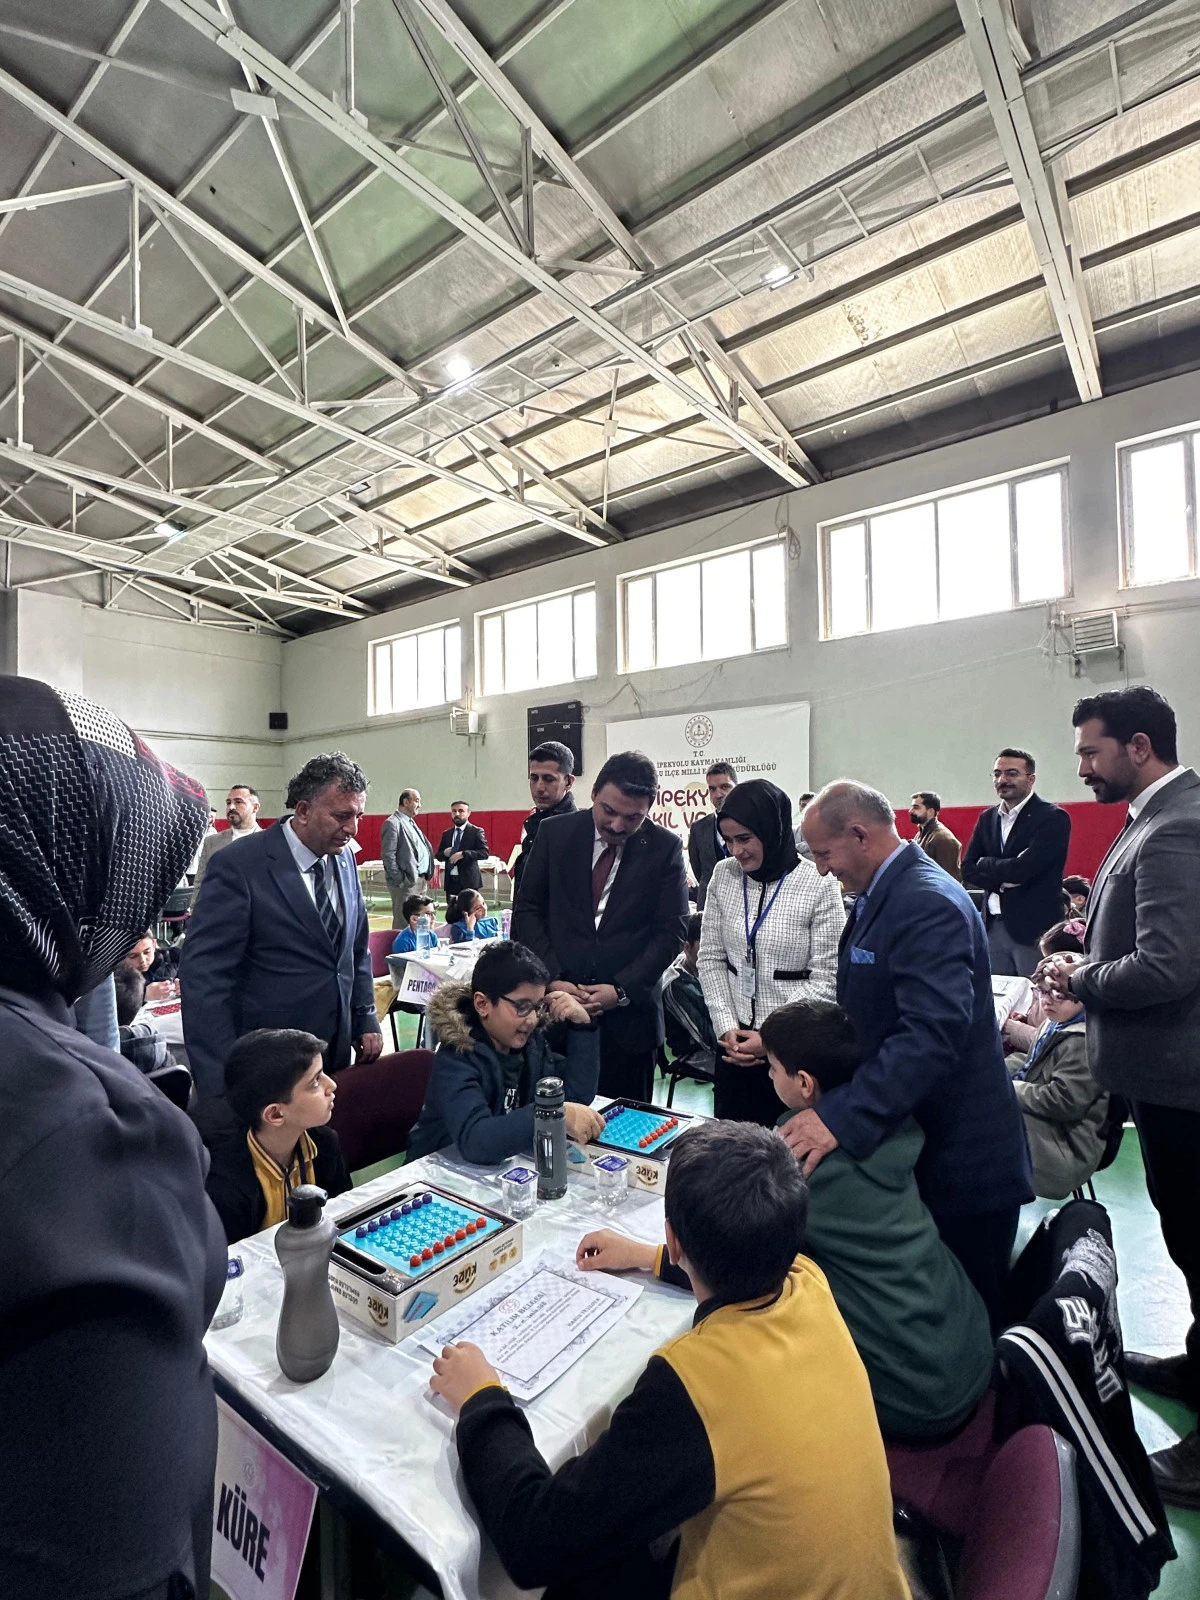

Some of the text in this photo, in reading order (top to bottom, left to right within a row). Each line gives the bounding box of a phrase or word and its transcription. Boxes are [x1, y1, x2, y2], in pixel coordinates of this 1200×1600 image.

[733, 762, 777, 772] ÜDÜRLÜĞÜ
[656, 784, 709, 807] İPEKY
[653, 812, 678, 828] KIL
[453, 1261, 477, 1287] KÜRE
[367, 1296, 389, 1320] KÜRE
[216, 1482, 271, 1583] KÜRE
